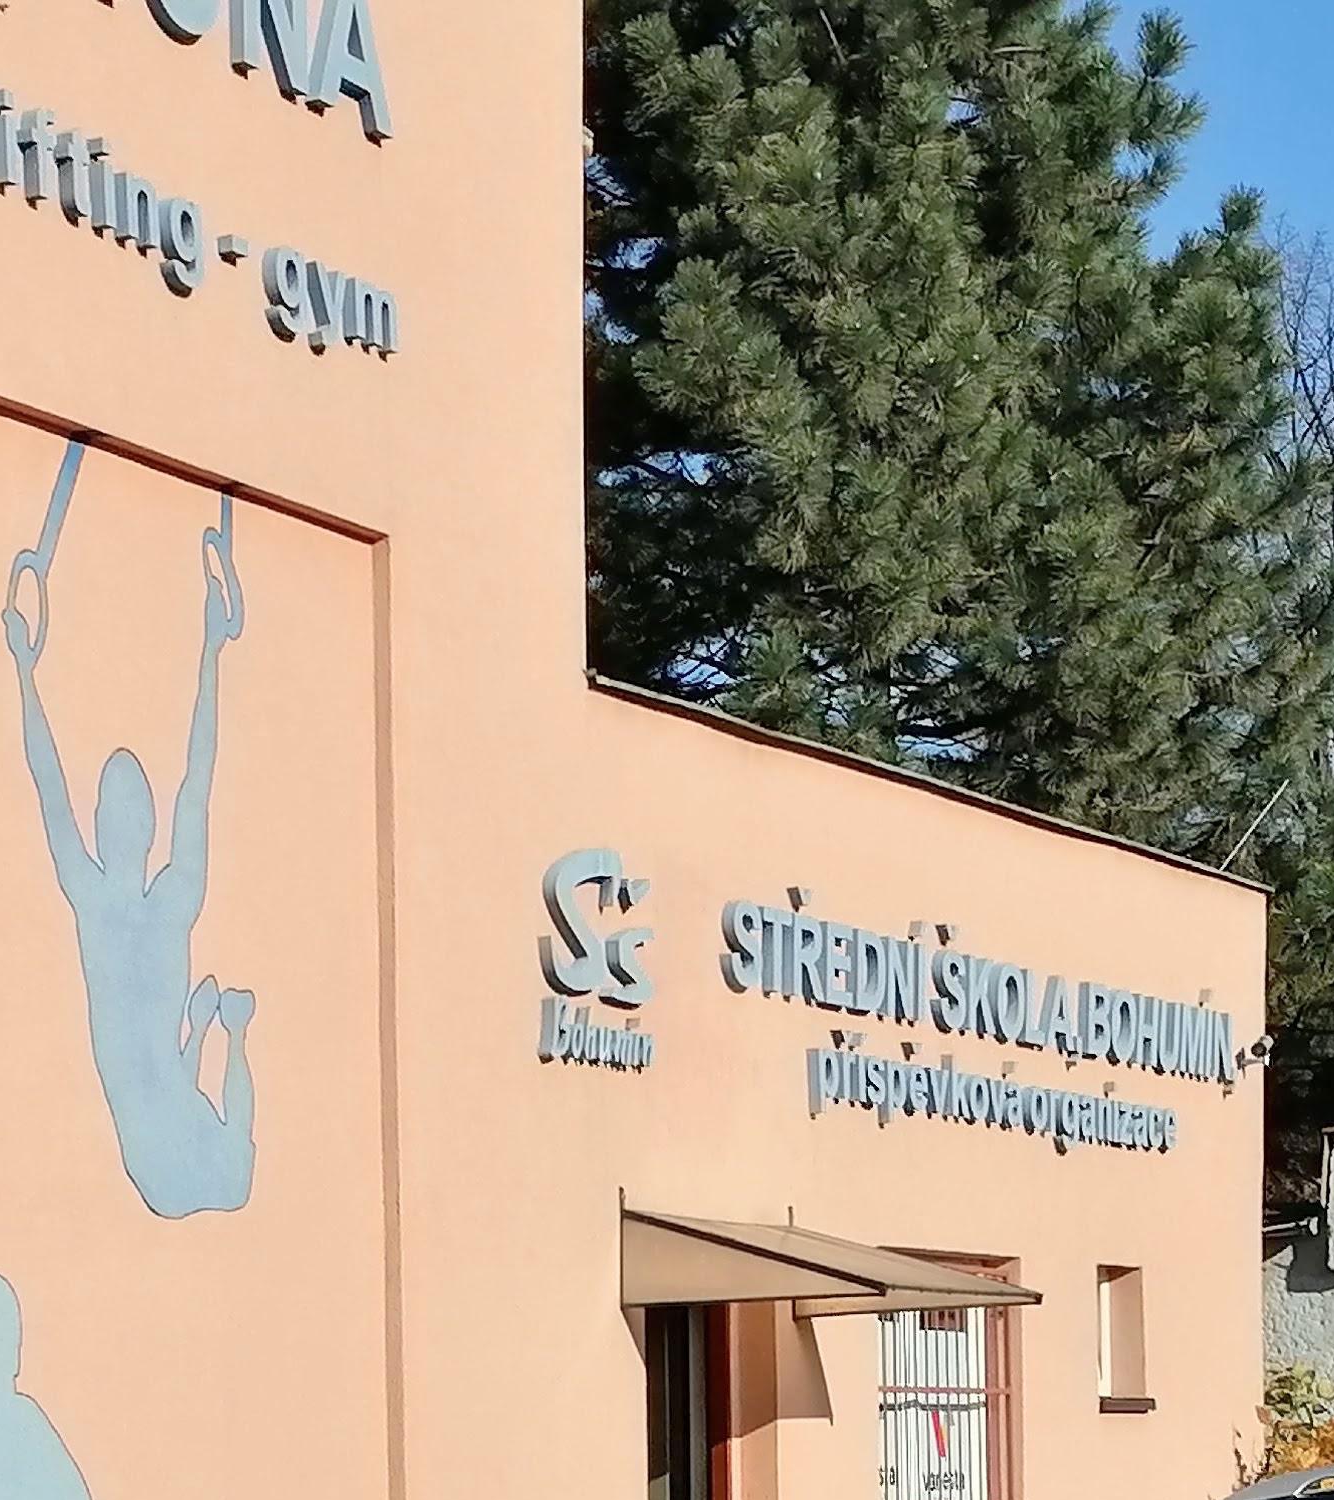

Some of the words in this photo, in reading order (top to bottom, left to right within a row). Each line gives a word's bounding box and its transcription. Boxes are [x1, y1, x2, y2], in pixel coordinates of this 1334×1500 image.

[263, 246, 398, 356] gym
[719, 887, 925, 1026] STŘEDNÍ
[1024, 1081, 1177, 1155] organizace
